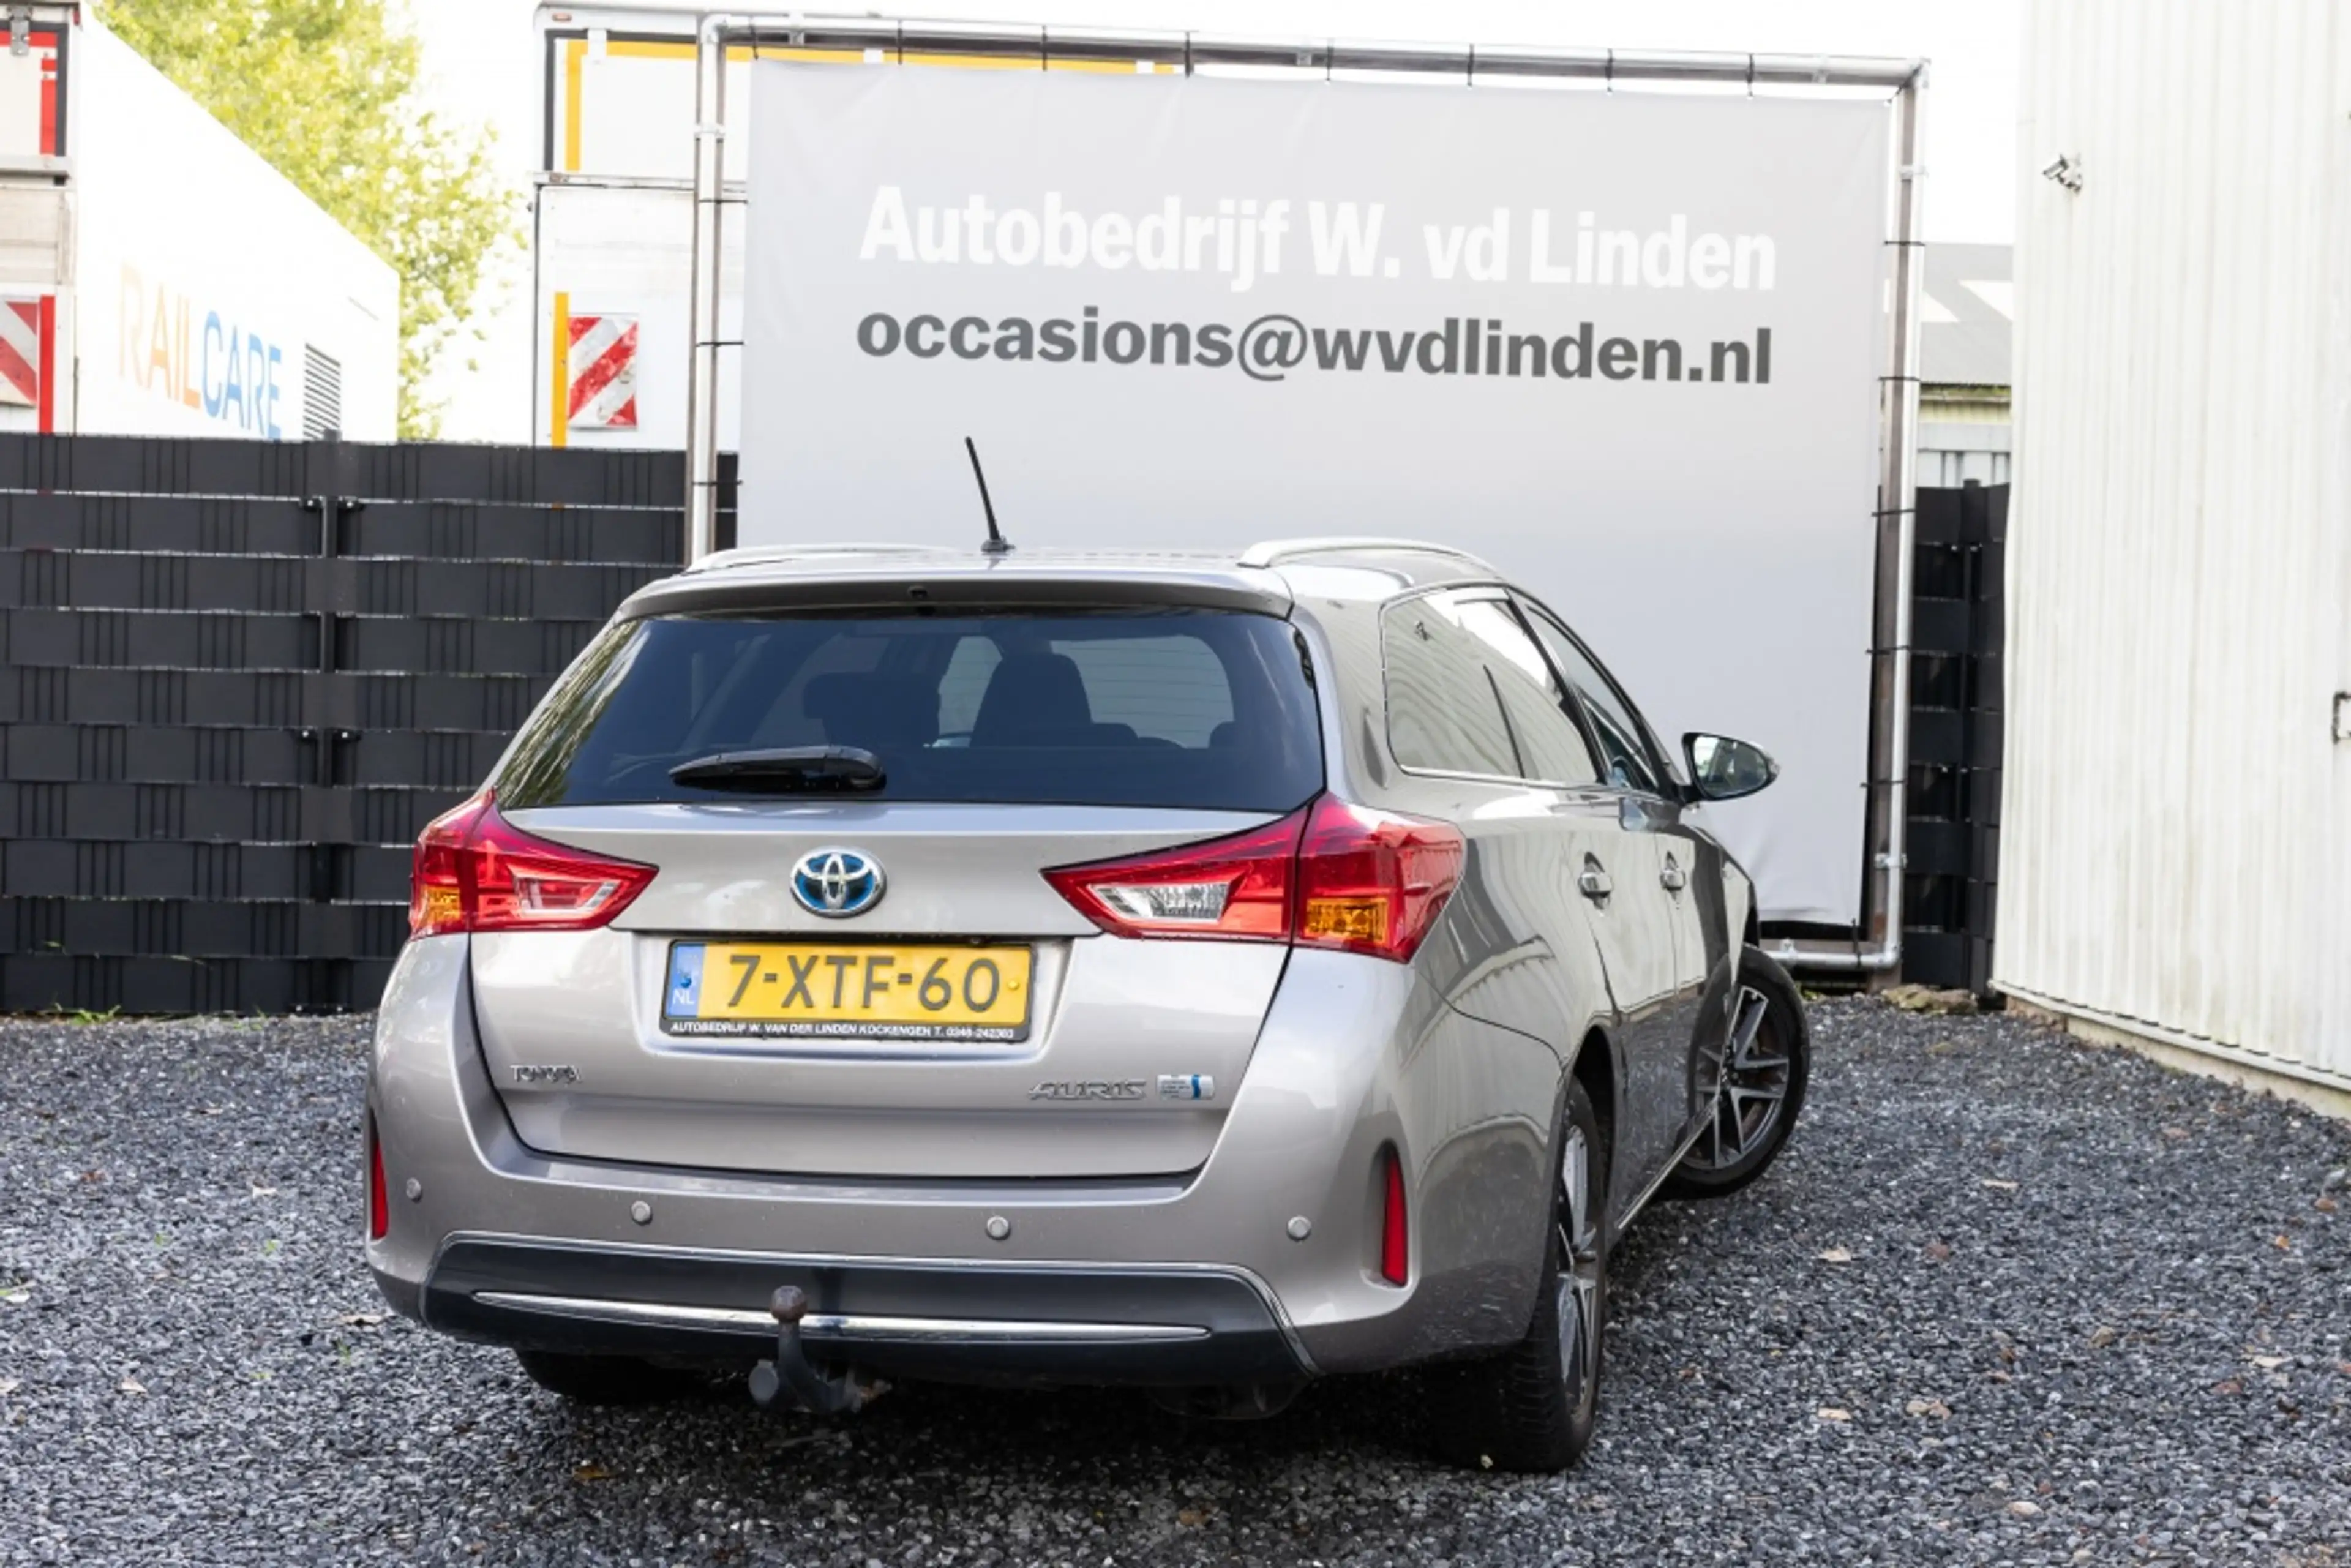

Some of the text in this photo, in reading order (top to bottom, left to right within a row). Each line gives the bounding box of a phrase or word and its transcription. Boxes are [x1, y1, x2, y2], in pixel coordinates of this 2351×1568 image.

[860, 184, 1776, 293] Autobedrijf W. vd Linden
[119, 263, 281, 442] RAILCARE
[856, 306, 1771, 384] occasions@wvdlinden.nl
[673, 989, 695, 1005] NL
[727, 953, 1000, 1013] 7-XTF-60
[670, 1021, 745, 1033] AUTOBEDRIJF
[765, 1023, 788, 1034] VAN
[790, 1024, 814, 1034] DER
[816, 1024, 857, 1035] LINDEN
[859, 1025, 931, 1036] KOCKENGEN
[1028, 1079, 1147, 1100] AURIS
